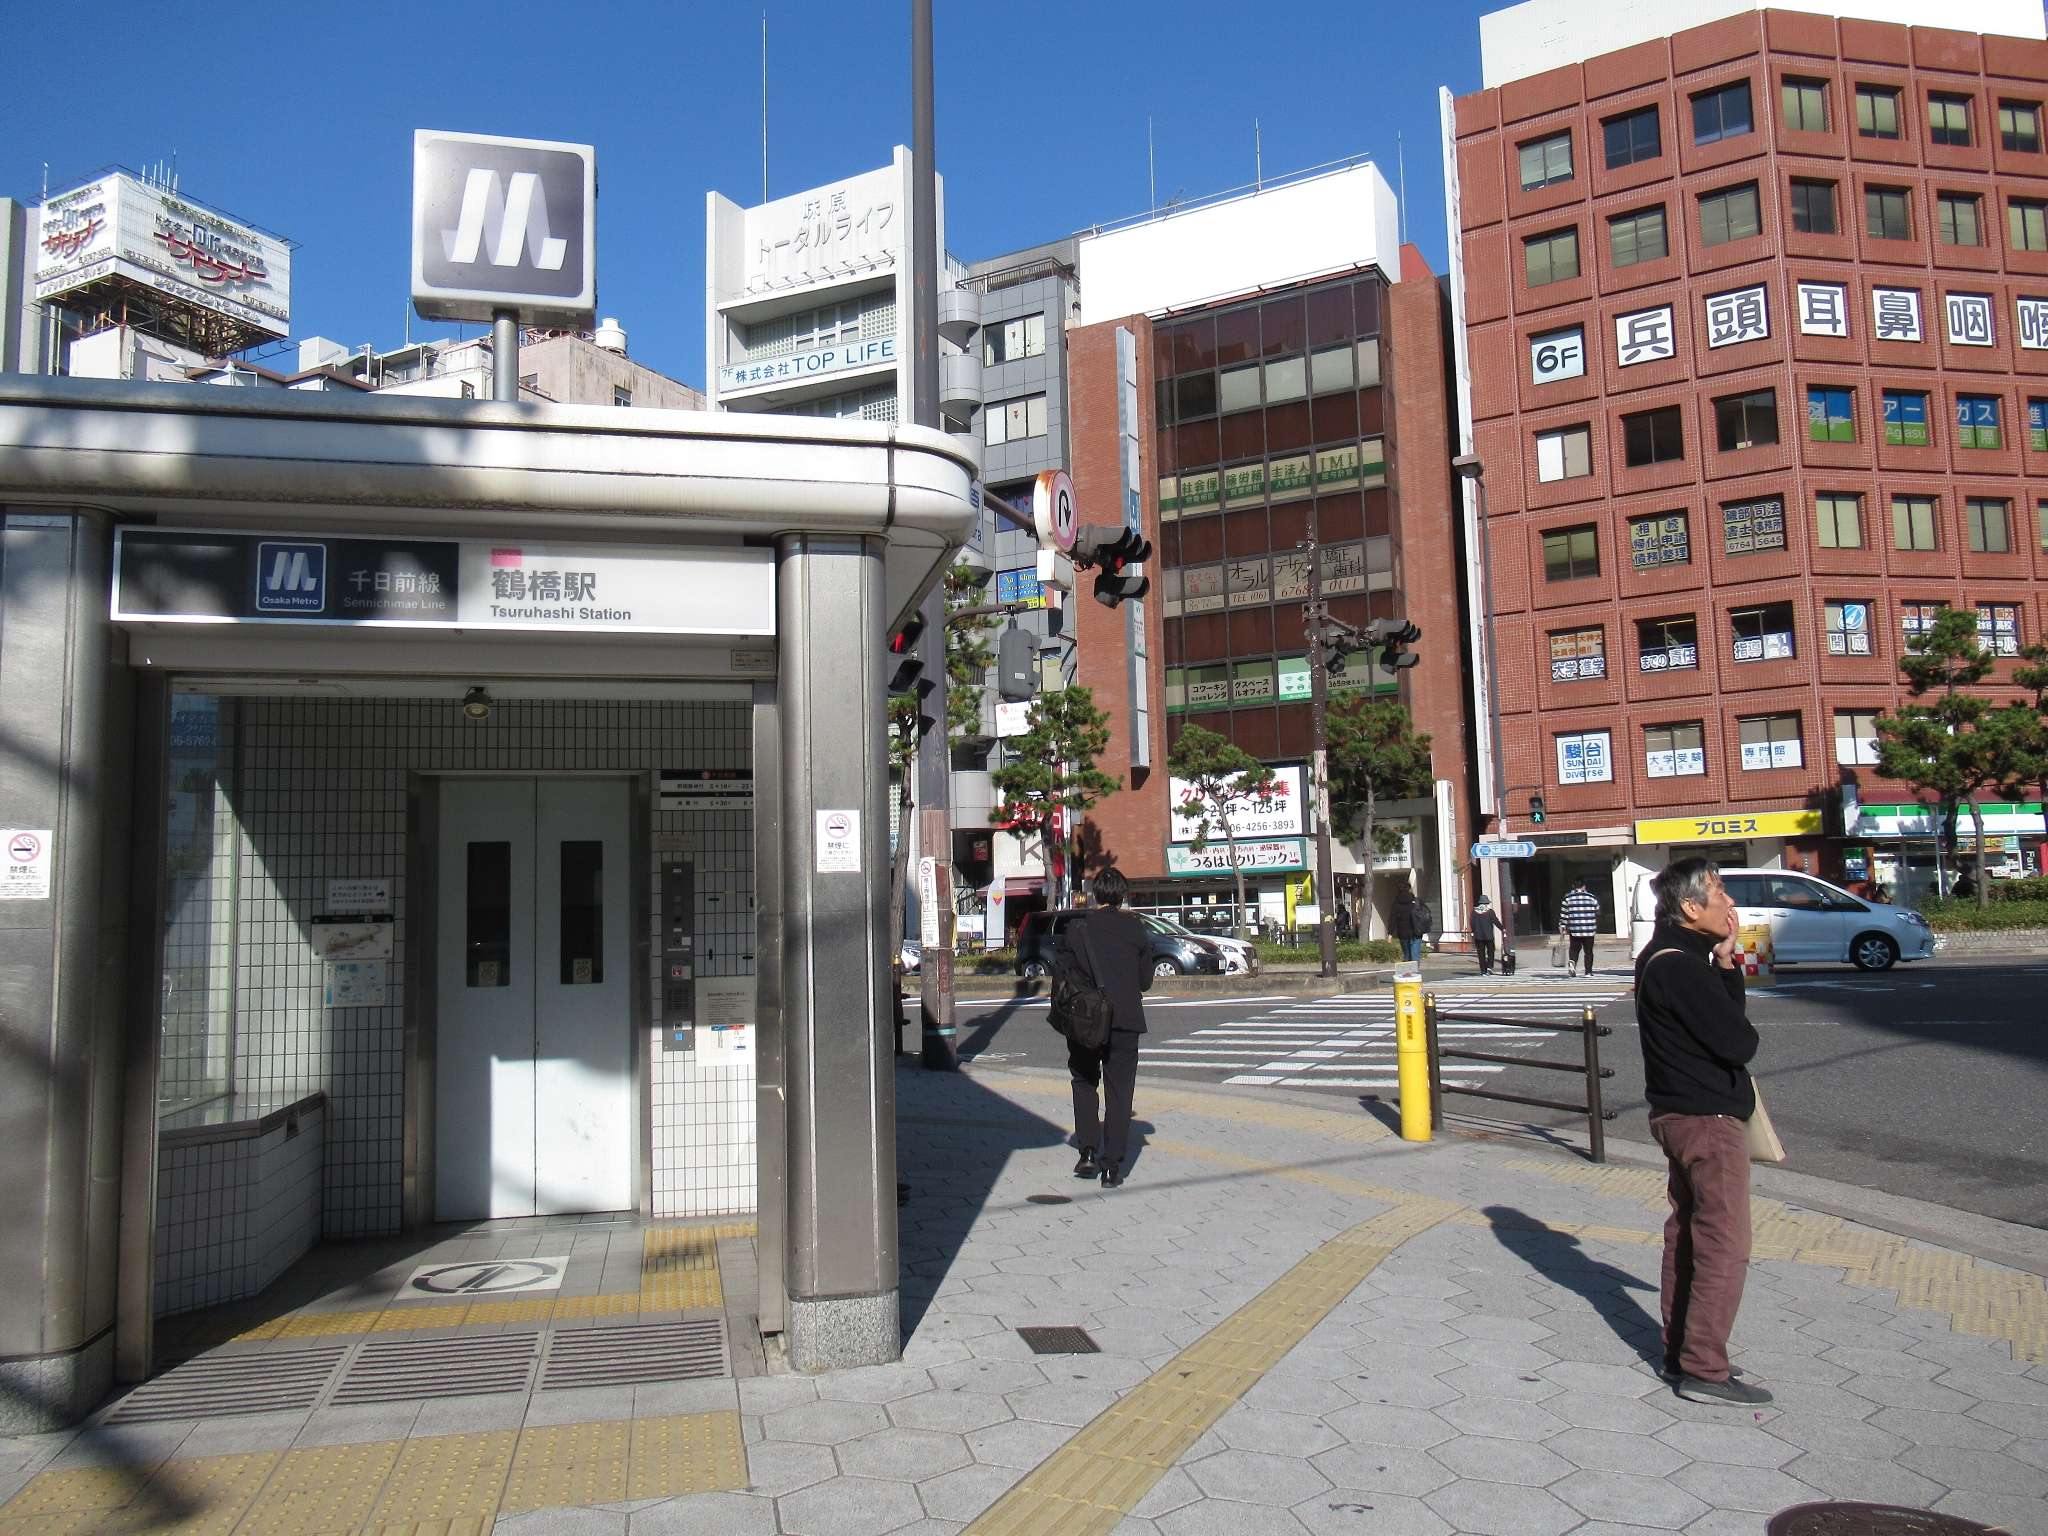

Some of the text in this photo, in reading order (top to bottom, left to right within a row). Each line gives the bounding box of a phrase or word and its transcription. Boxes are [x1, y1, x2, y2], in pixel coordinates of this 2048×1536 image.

[760, 201, 894, 263] トータルライフ
[721, 338, 894, 384] 7F 株式会社 TOP LIFE
[1536, 345, 1578, 374] 6F
[1319, 452, 1353, 470] IMI
[349, 570, 441, 595] 千日前線
[490, 567, 598, 603] 鶴橋駅
[262, 595, 319, 607] Osaka Metro
[344, 596, 446, 611] Sennichimae Line
[490, 604, 632, 622] Tsuruhashi Station
[1829, 634, 1869, 652] 開成
[1192, 678, 1269, 693] コワーキングスペース
[1565, 742, 1601, 759] 駿台
[1649, 752, 1703, 766] 大学受験
[1744, 745, 1786, 758] 専門館
[1695, 819, 1758, 836] プロミス
[1190, 852, 1288, 870] つるはしクリニック
